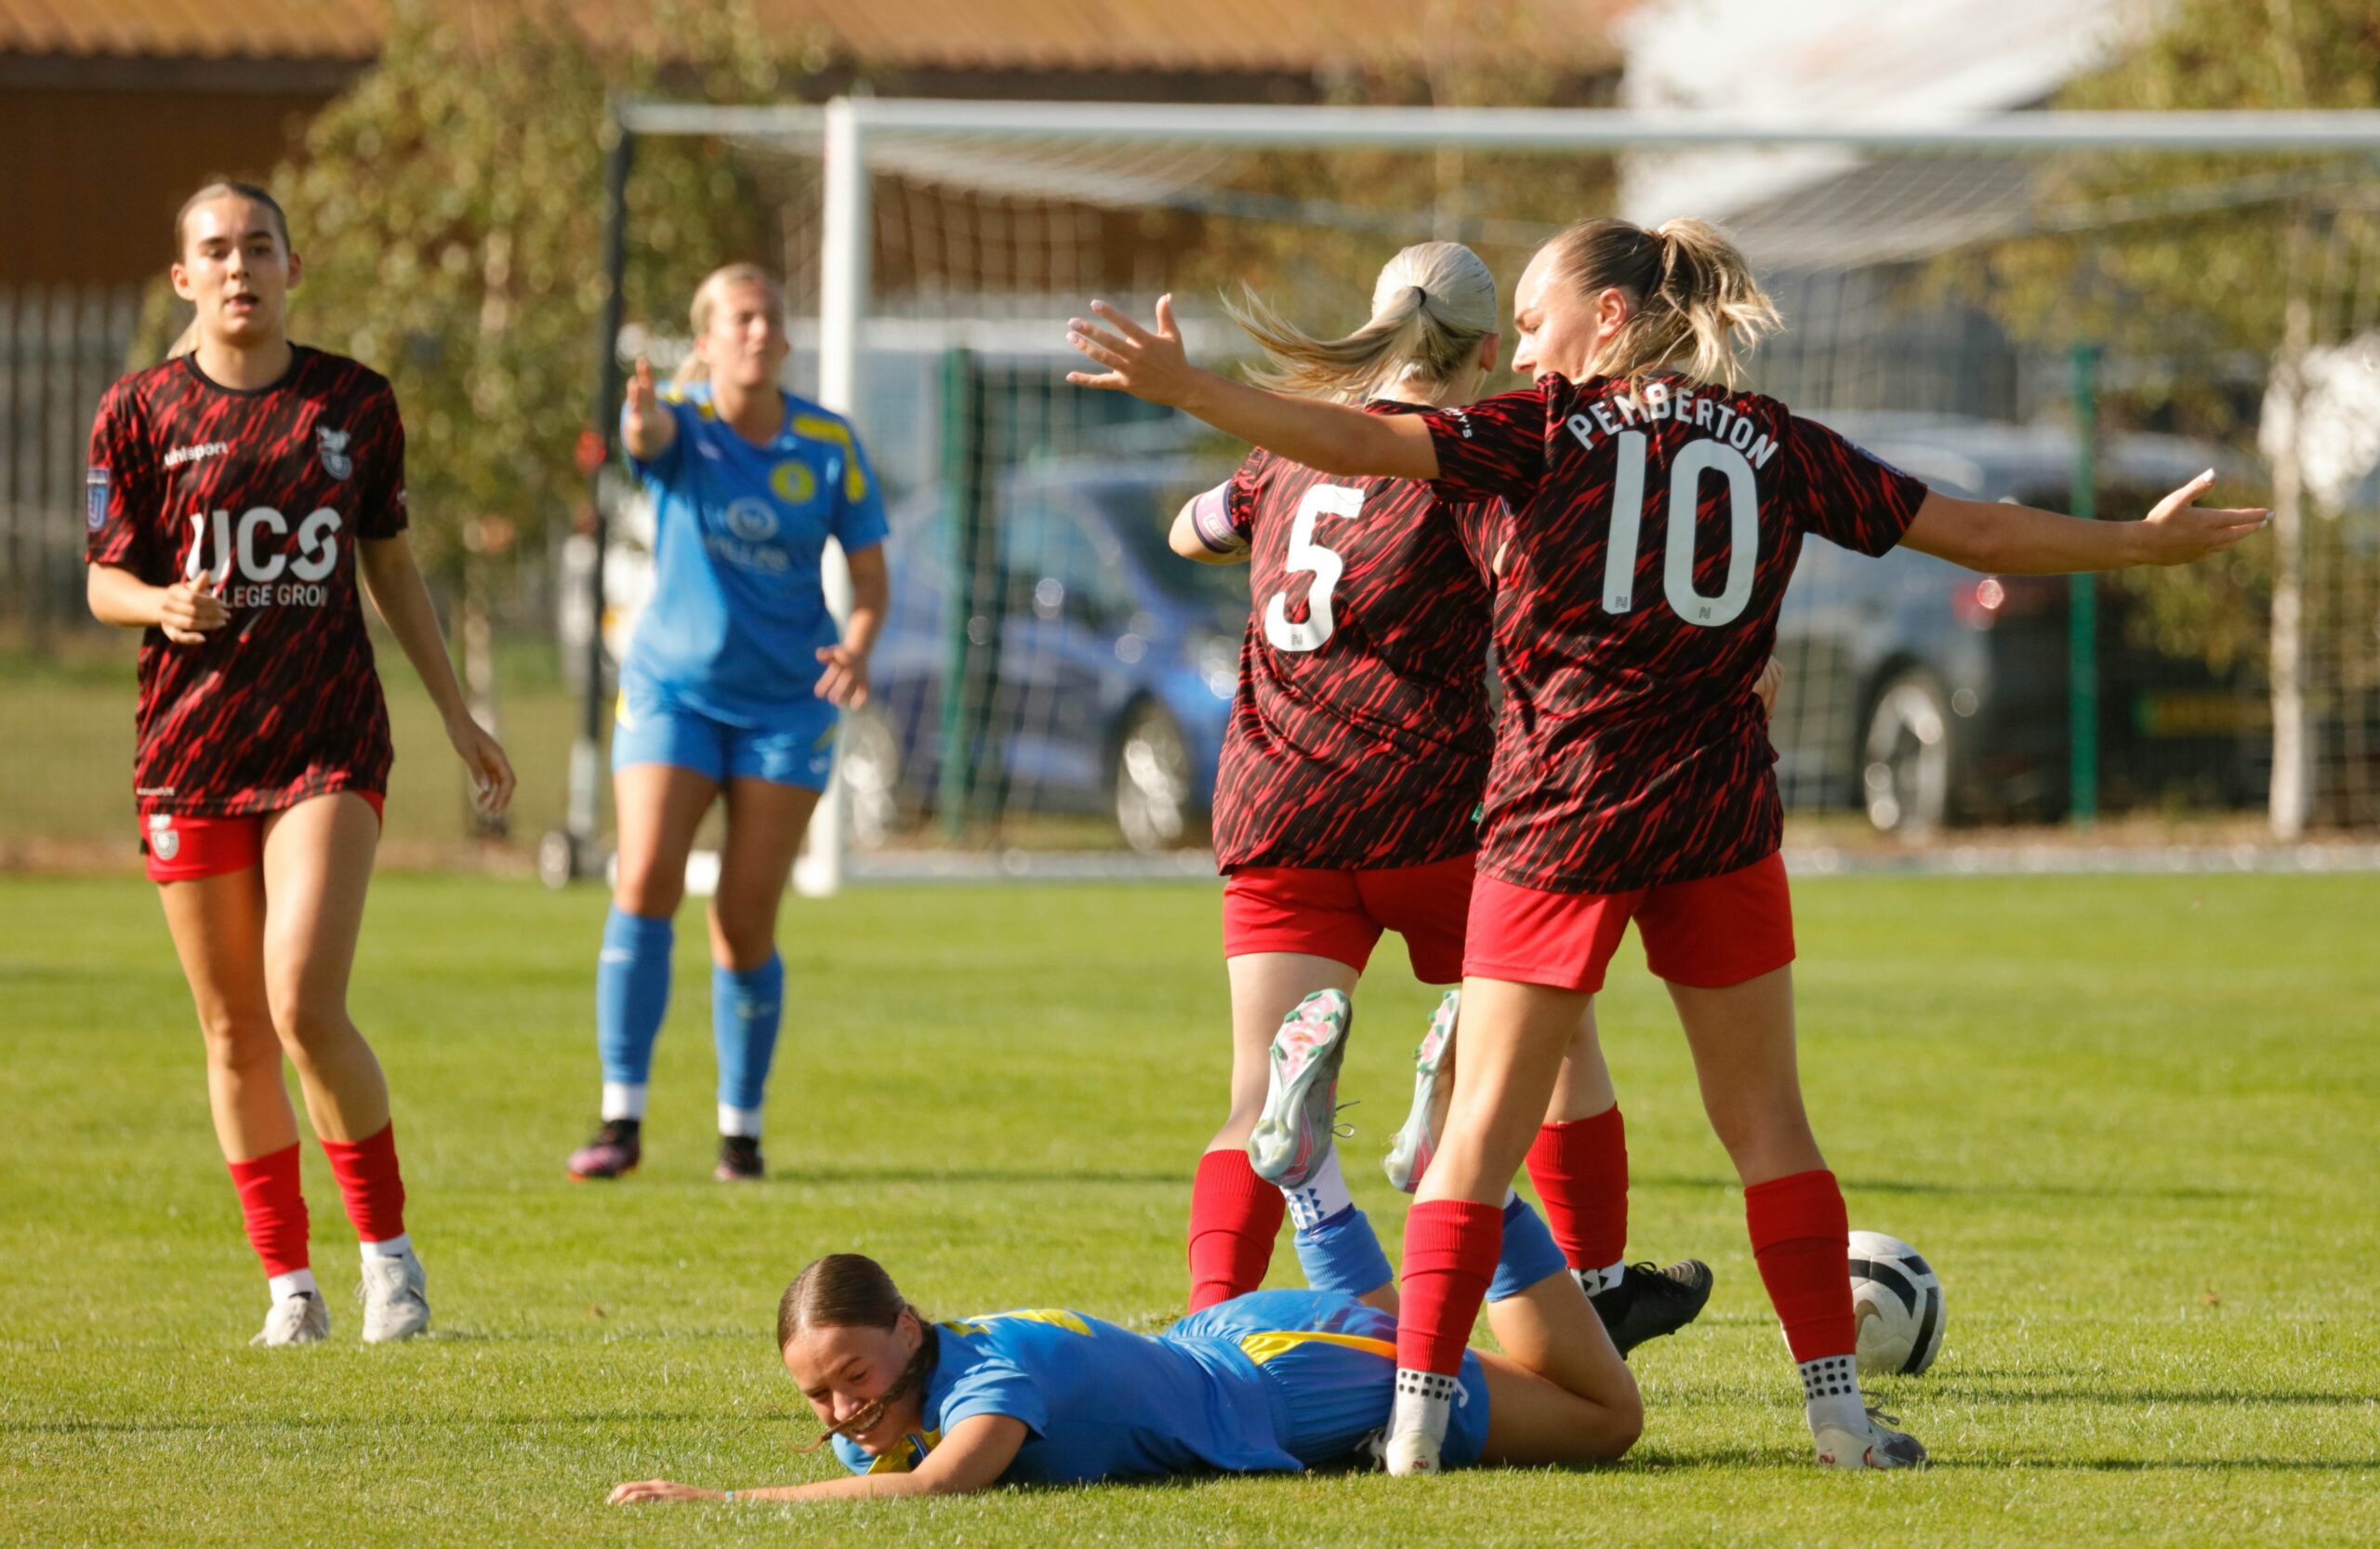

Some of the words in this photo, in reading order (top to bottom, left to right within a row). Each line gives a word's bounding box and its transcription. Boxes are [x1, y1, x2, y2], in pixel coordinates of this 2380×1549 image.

[164, 441, 229, 466] uhlsport
[1566, 382, 1778, 470] PEMBERTON
[186, 505, 342, 583] UCS
[1264, 483, 1365, 652] 5
[1602, 430, 1759, 627] 10
